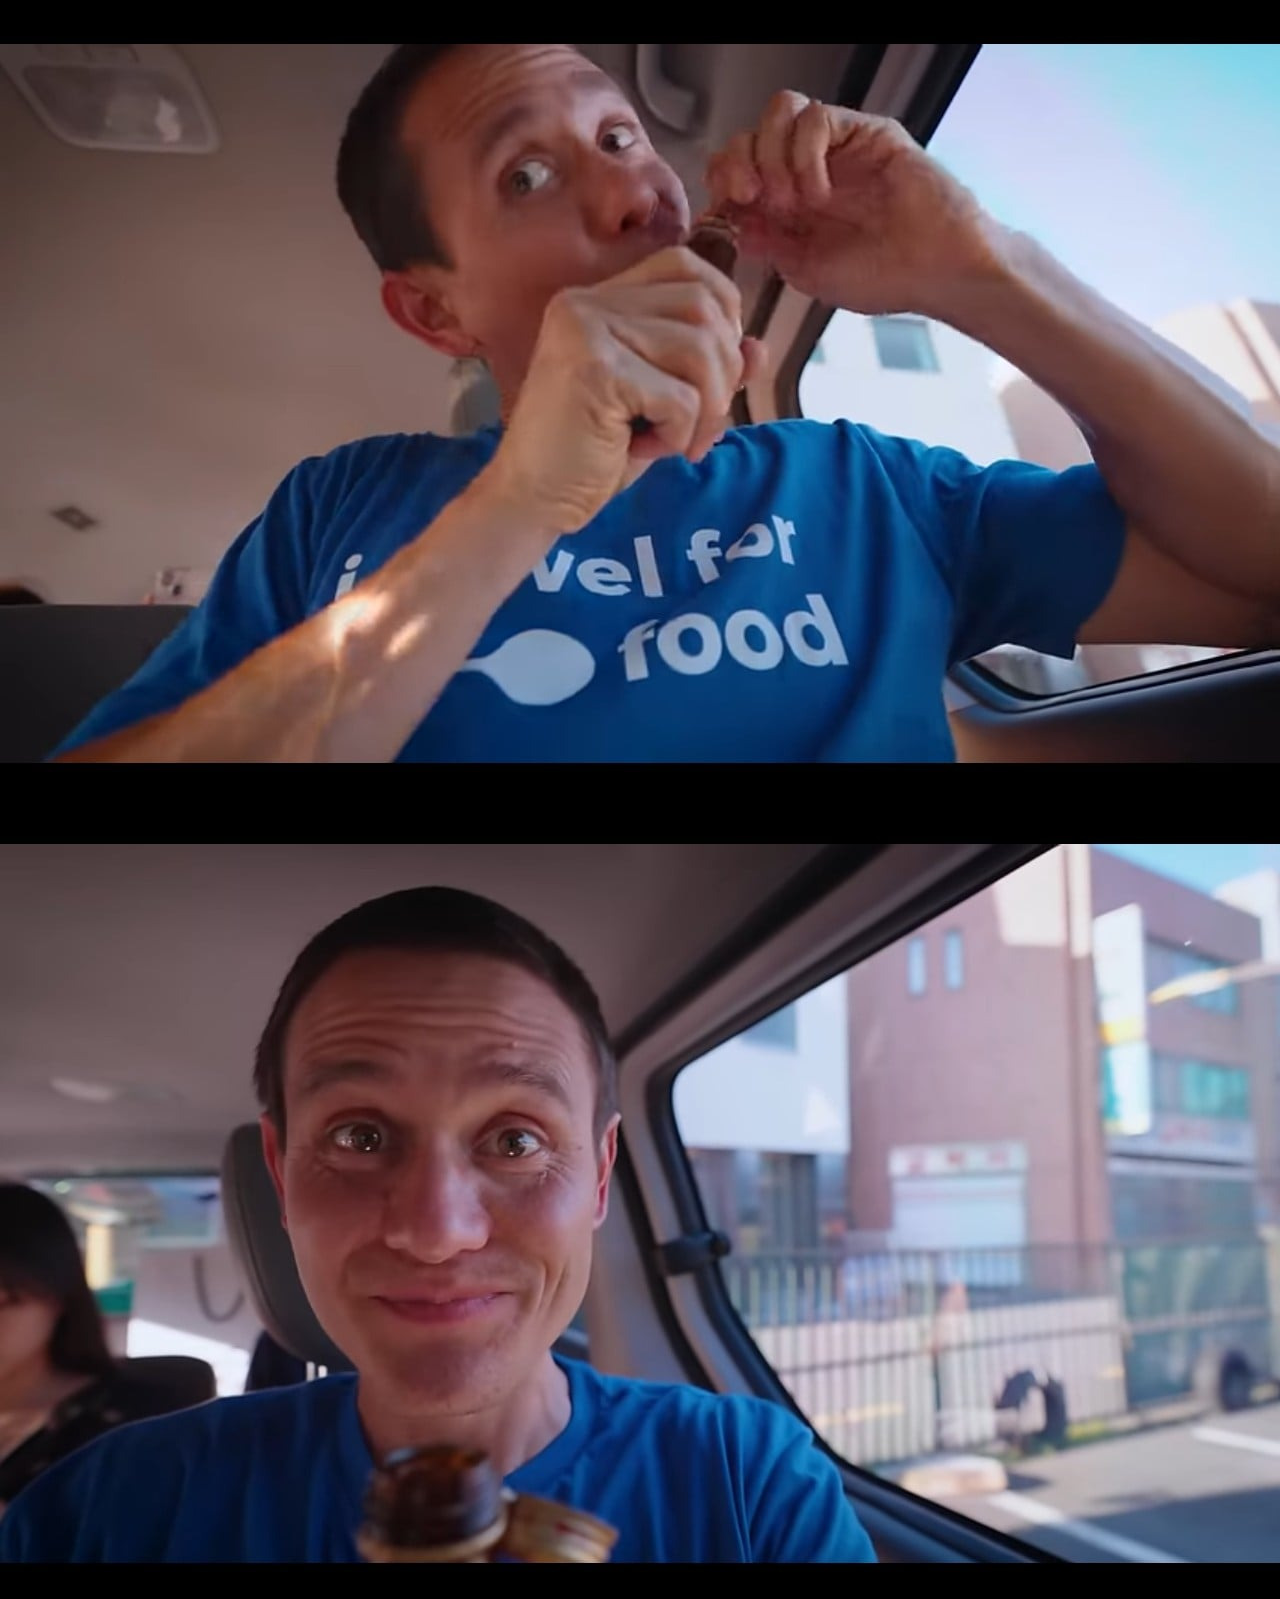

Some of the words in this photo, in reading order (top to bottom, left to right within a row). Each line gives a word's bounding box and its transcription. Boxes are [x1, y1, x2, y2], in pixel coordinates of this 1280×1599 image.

[532, 535, 664, 599] vel
[686, 514, 797, 584] for
[617, 593, 850, 683] food
